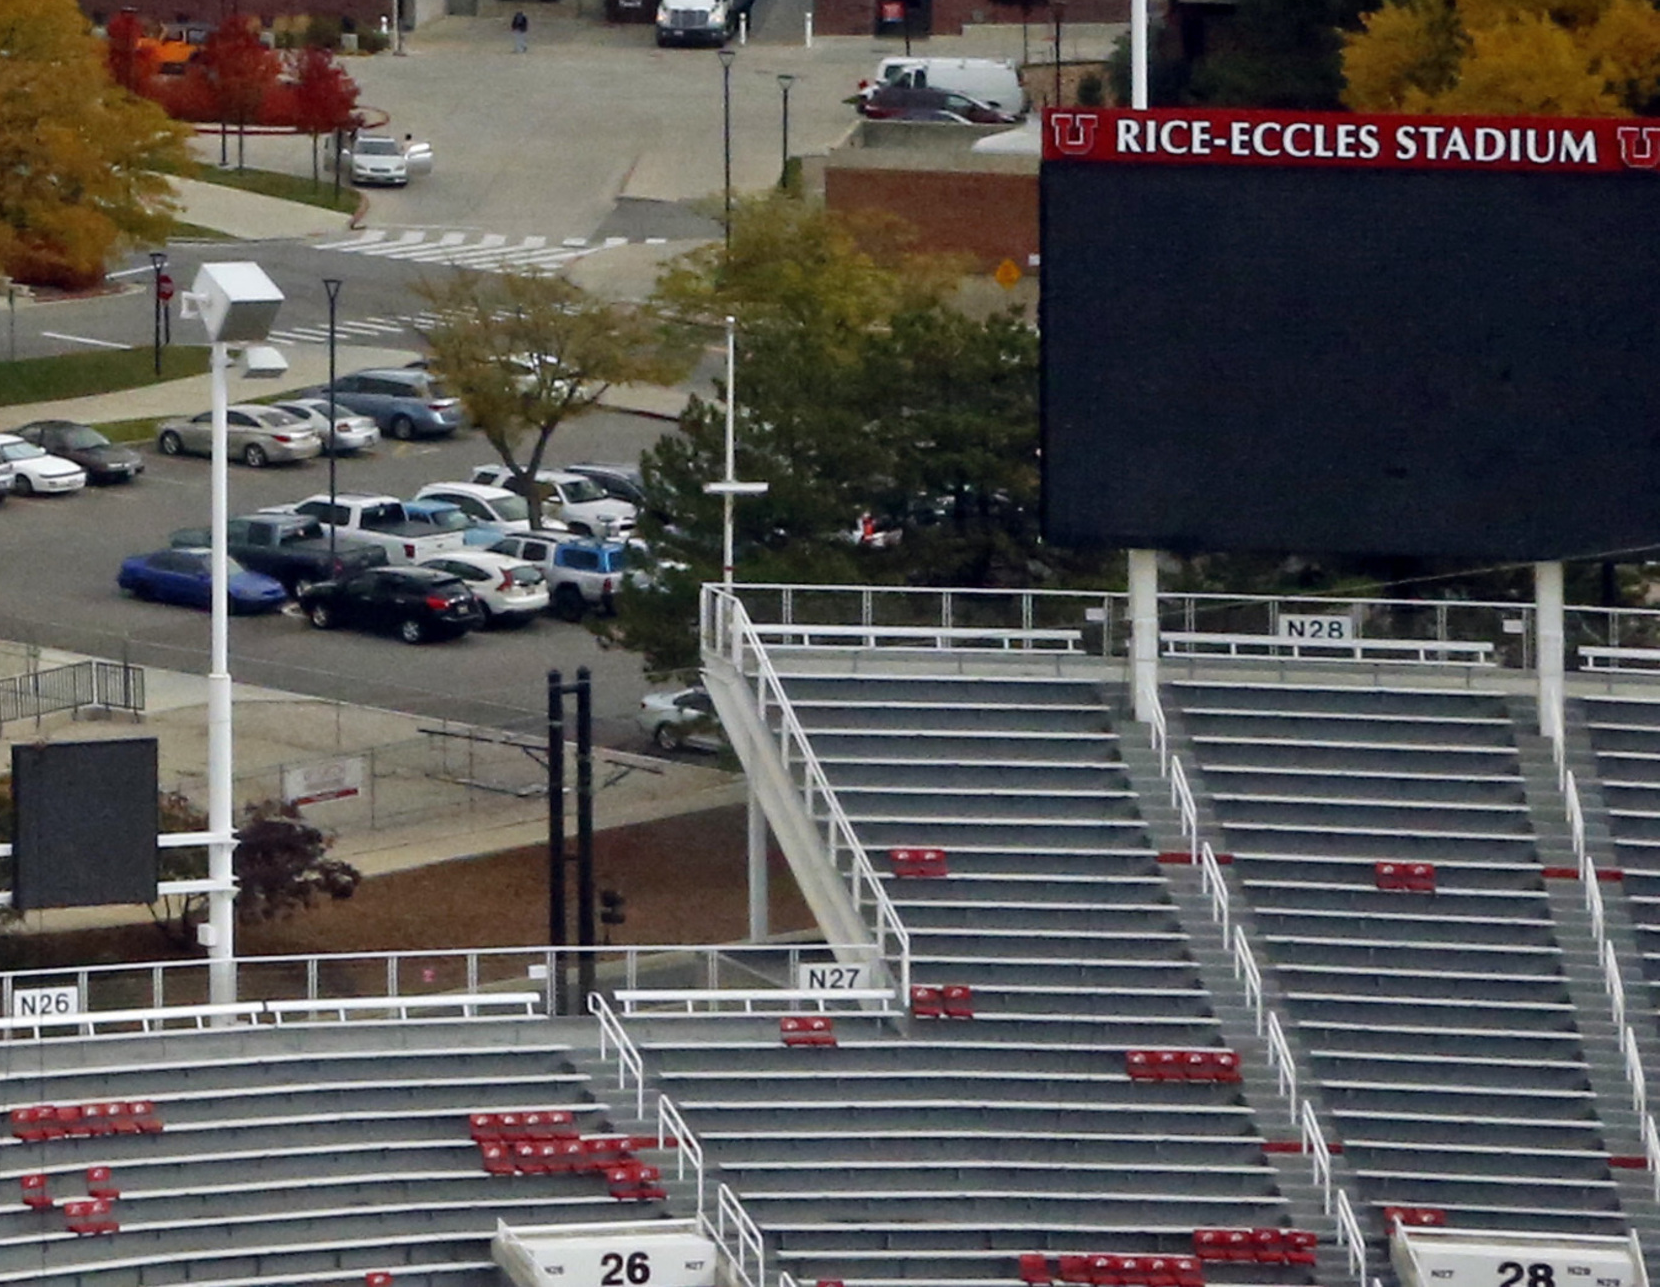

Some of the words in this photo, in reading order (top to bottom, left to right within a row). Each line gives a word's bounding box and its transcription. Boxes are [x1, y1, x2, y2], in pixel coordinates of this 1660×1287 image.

[1117, 118, 1380, 159] RICE-ECCLES
[1396, 124, 1599, 164] STADIUM
[1287, 620, 1344, 639] N28
[809, 968, 860, 989] N27
[21, 993, 70, 1016] N26
[601, 1251, 650, 1286] 26
[1497, 1261, 1556, 1287] 28
